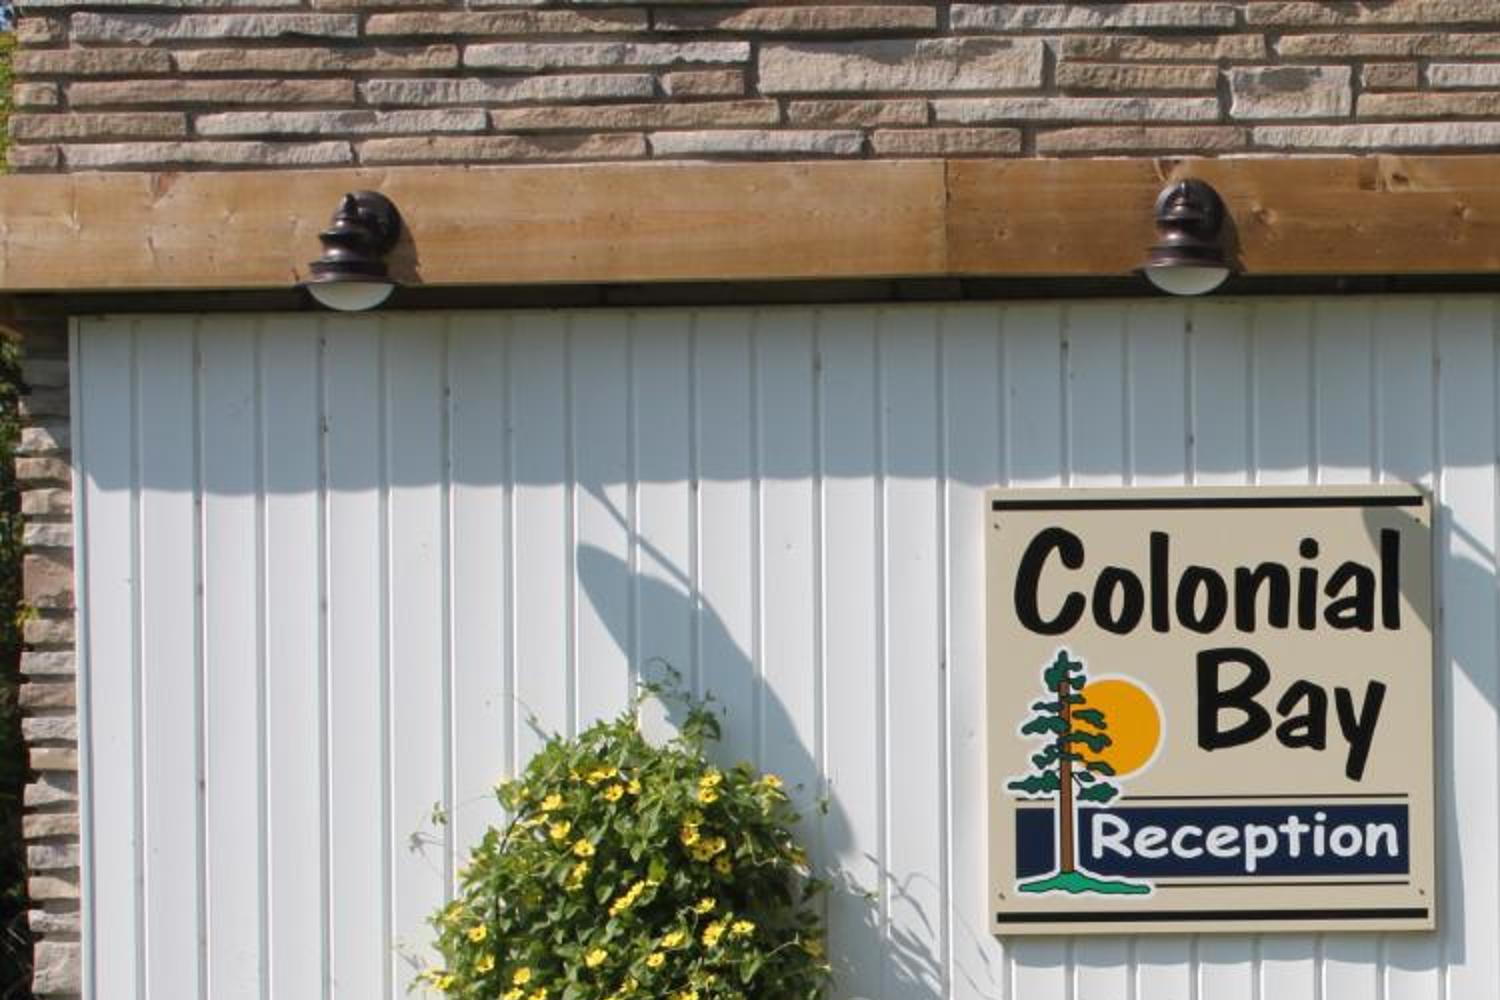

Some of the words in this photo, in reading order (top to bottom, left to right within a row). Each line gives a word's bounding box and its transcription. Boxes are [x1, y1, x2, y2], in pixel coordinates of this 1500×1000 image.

[1014, 527, 1401, 635] Colonial
[1196, 647, 1387, 782] Bay
[1091, 812, 1399, 873] Reception
